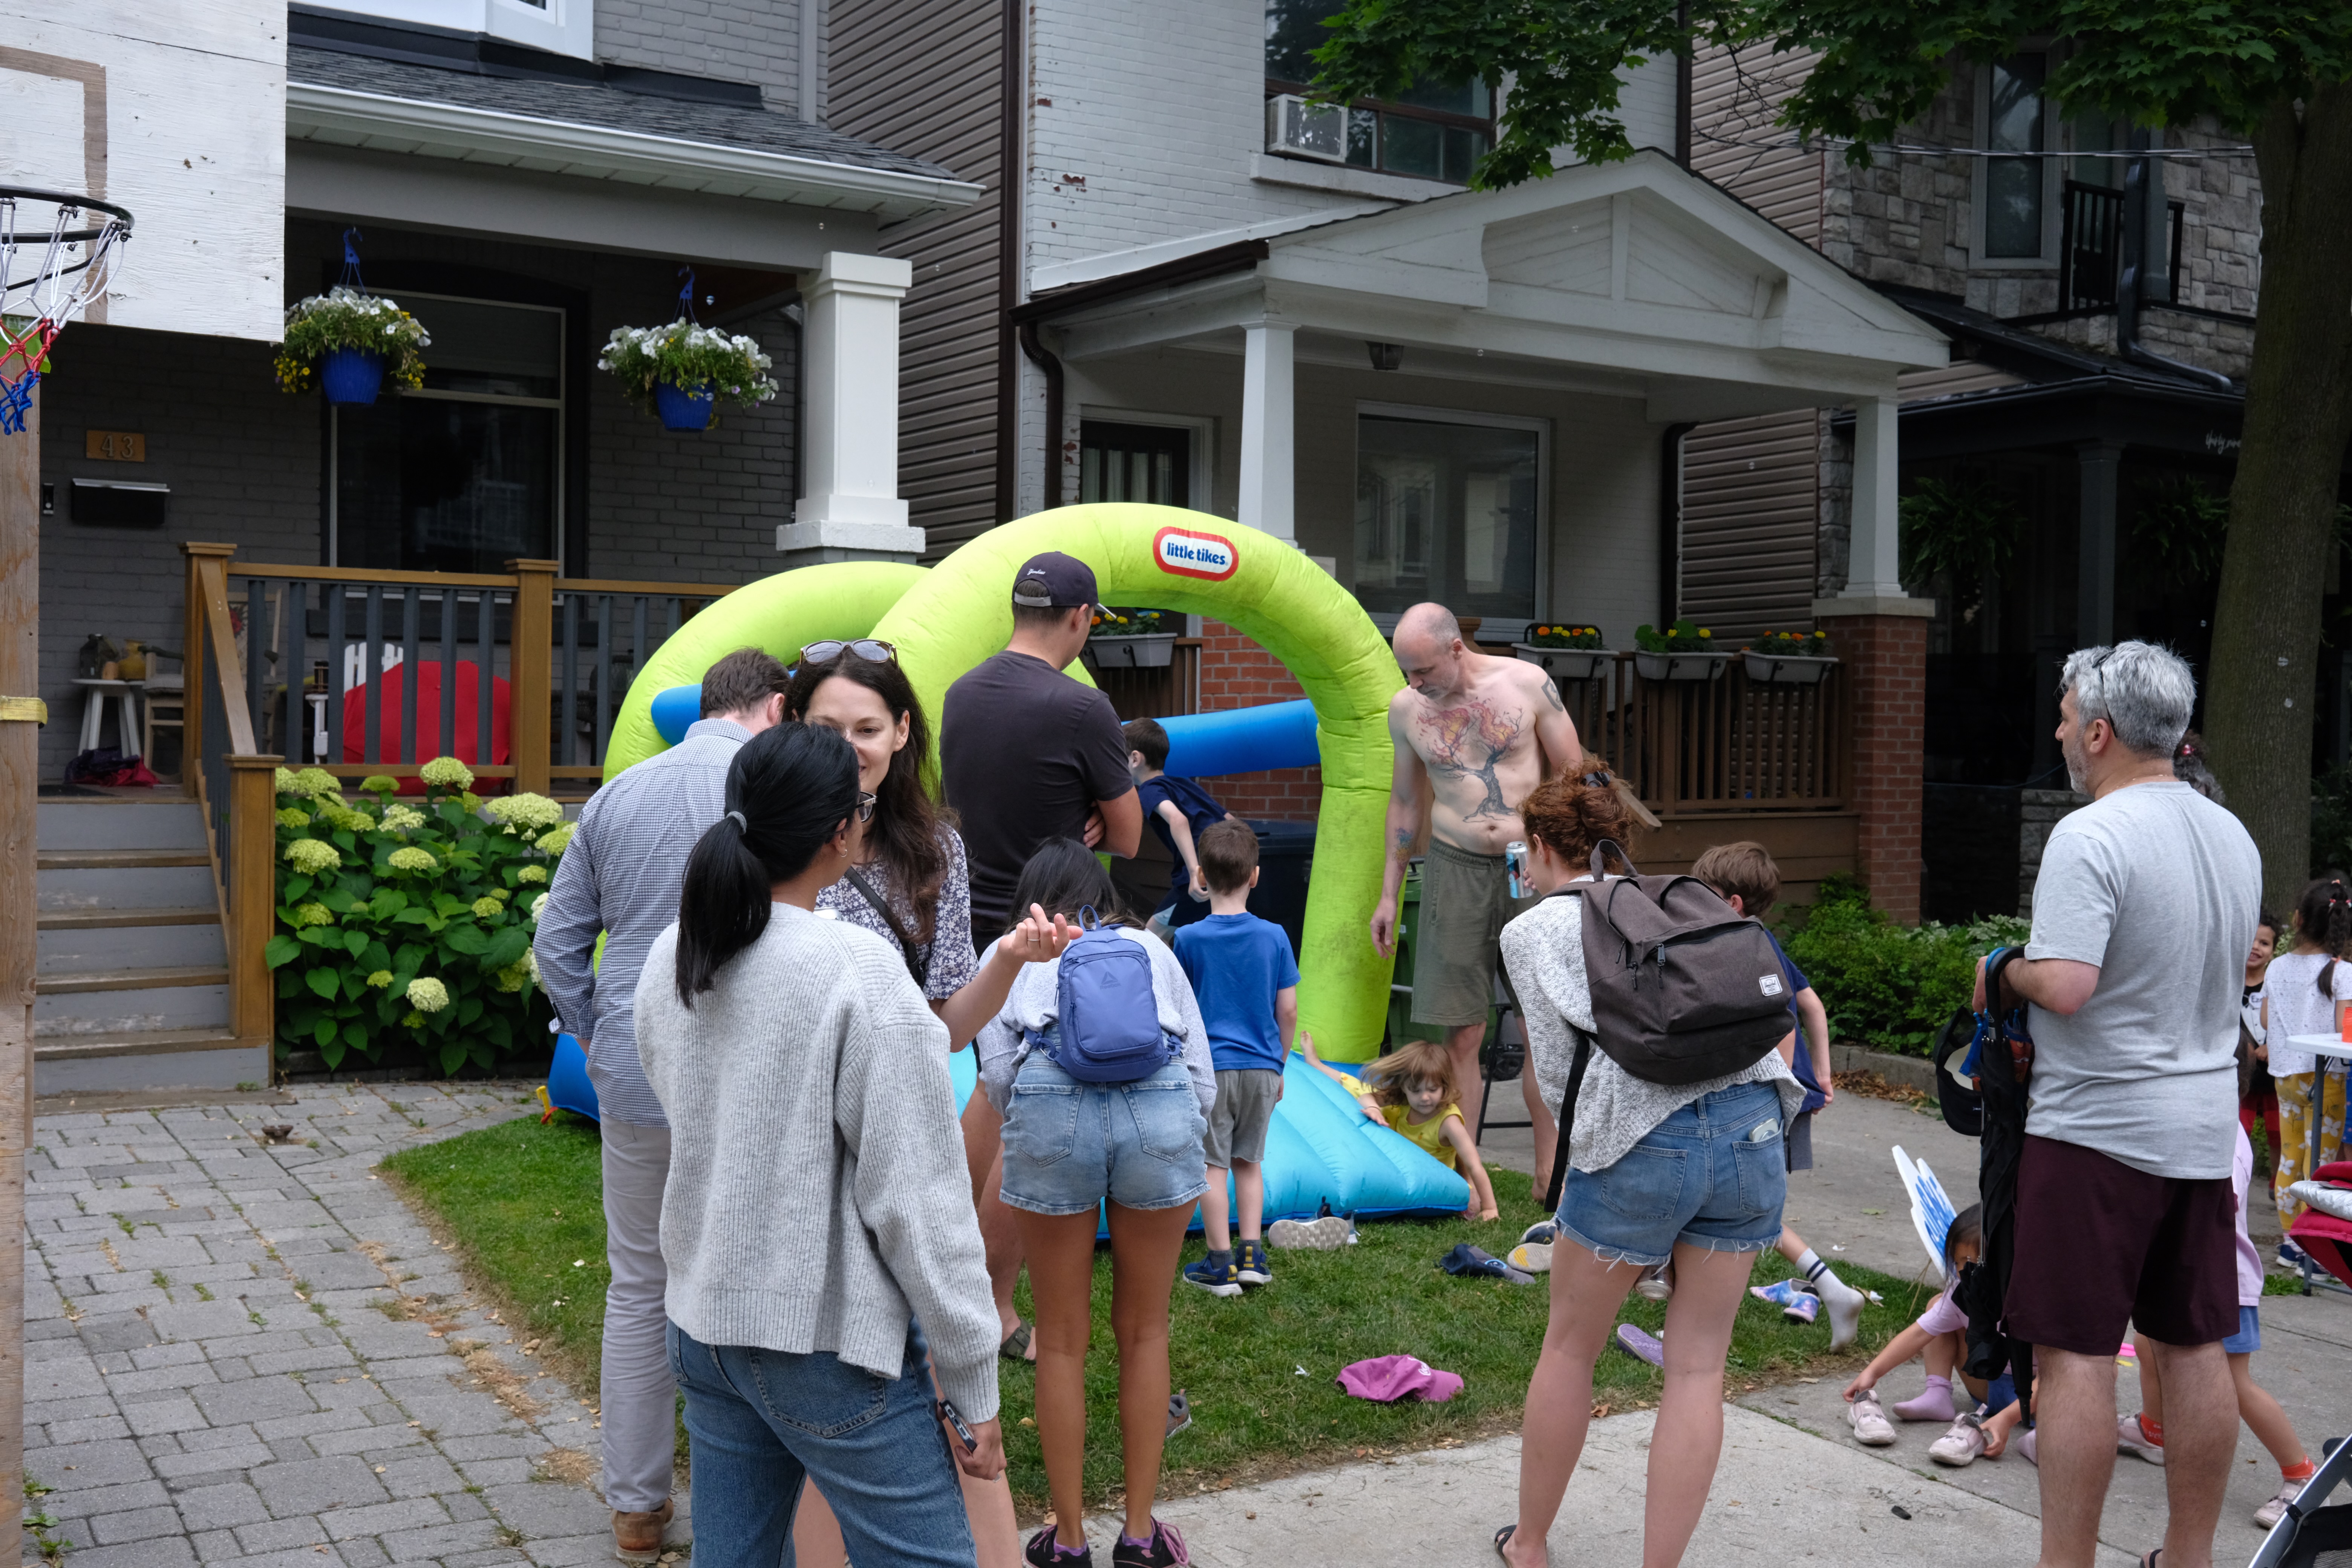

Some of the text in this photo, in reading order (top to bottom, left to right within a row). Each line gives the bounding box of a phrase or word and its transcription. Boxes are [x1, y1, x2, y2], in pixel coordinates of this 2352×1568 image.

[101, 434, 134, 458] 43
[1167, 542, 1225, 565] little tikes
